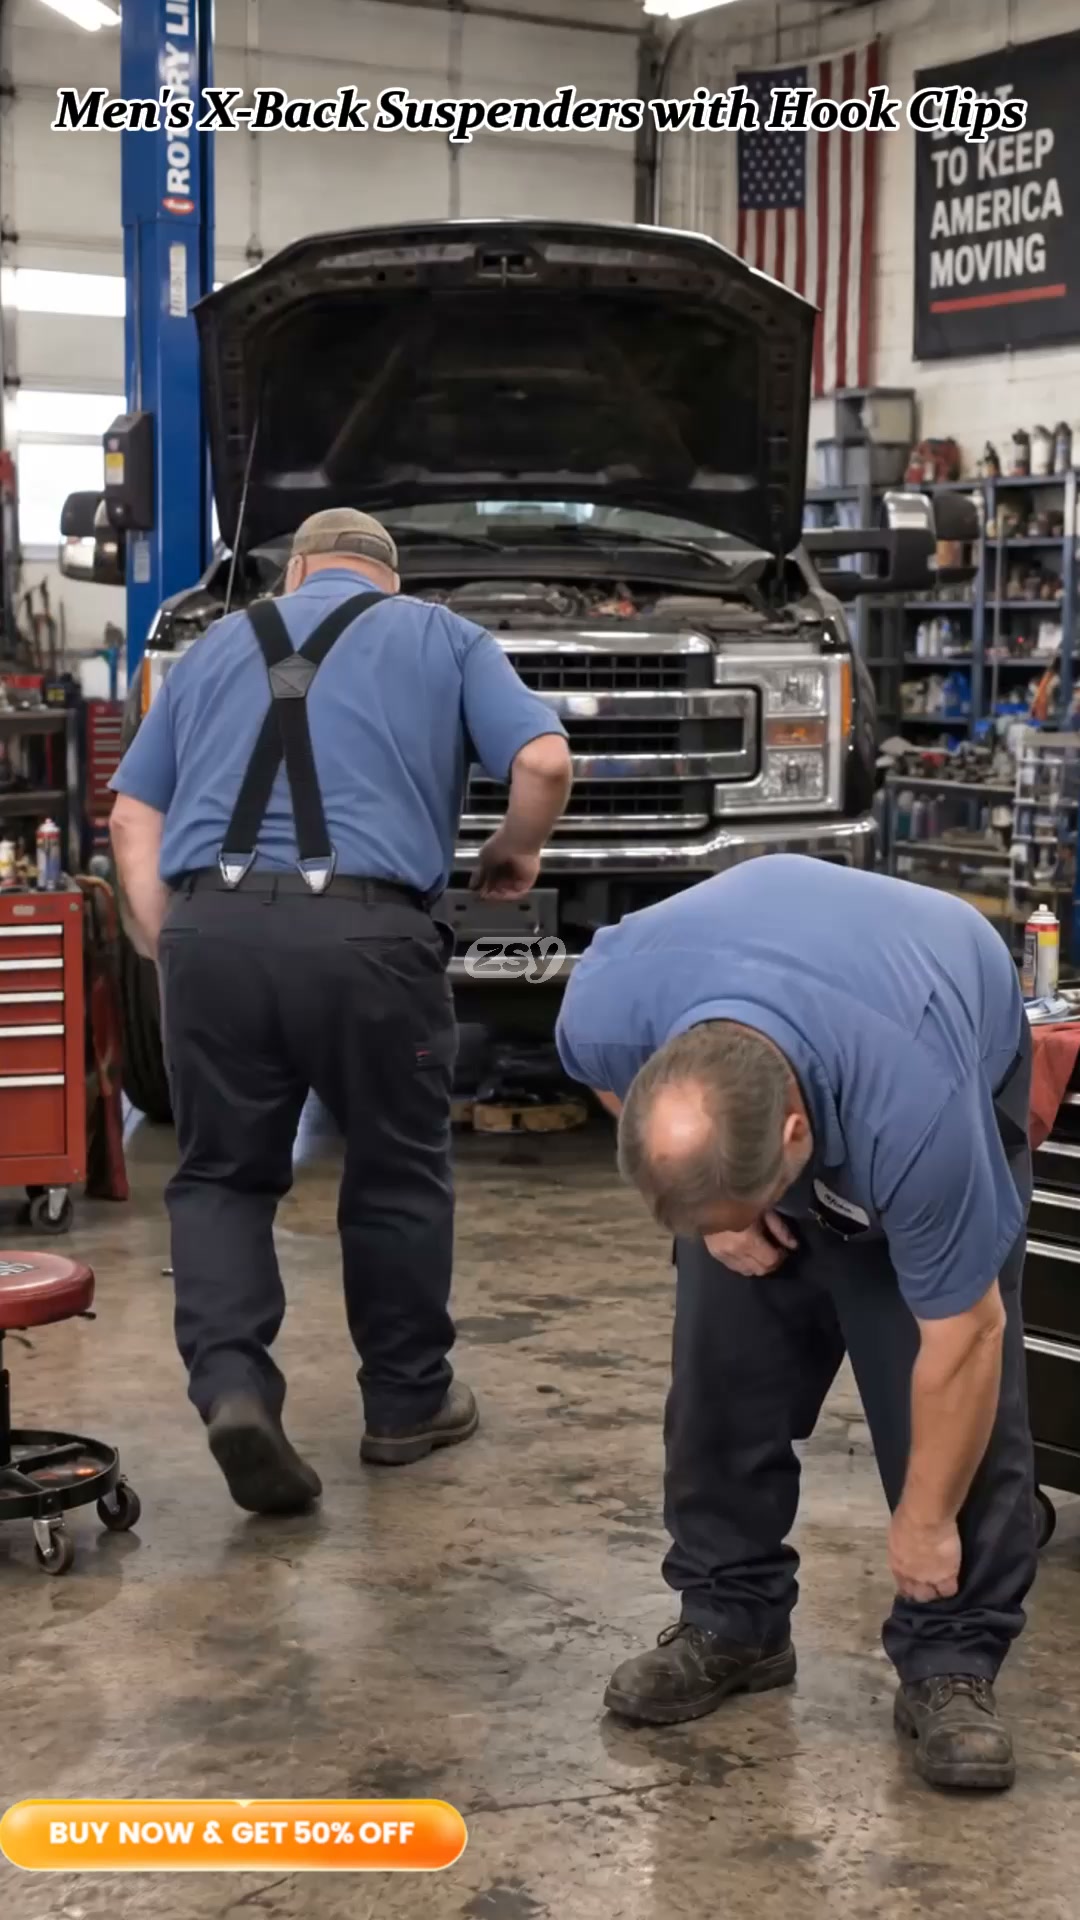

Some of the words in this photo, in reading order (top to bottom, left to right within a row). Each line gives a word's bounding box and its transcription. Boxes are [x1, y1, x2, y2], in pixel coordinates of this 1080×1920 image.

[166, 0, 189, 36] LI
[166, 41, 190, 195] RORY
[930, 145, 969, 189] TO
[977, 127, 1055, 180] KEEP
[929, 177, 1064, 240] AMERICA
[929, 232, 1046, 289] MOVING
